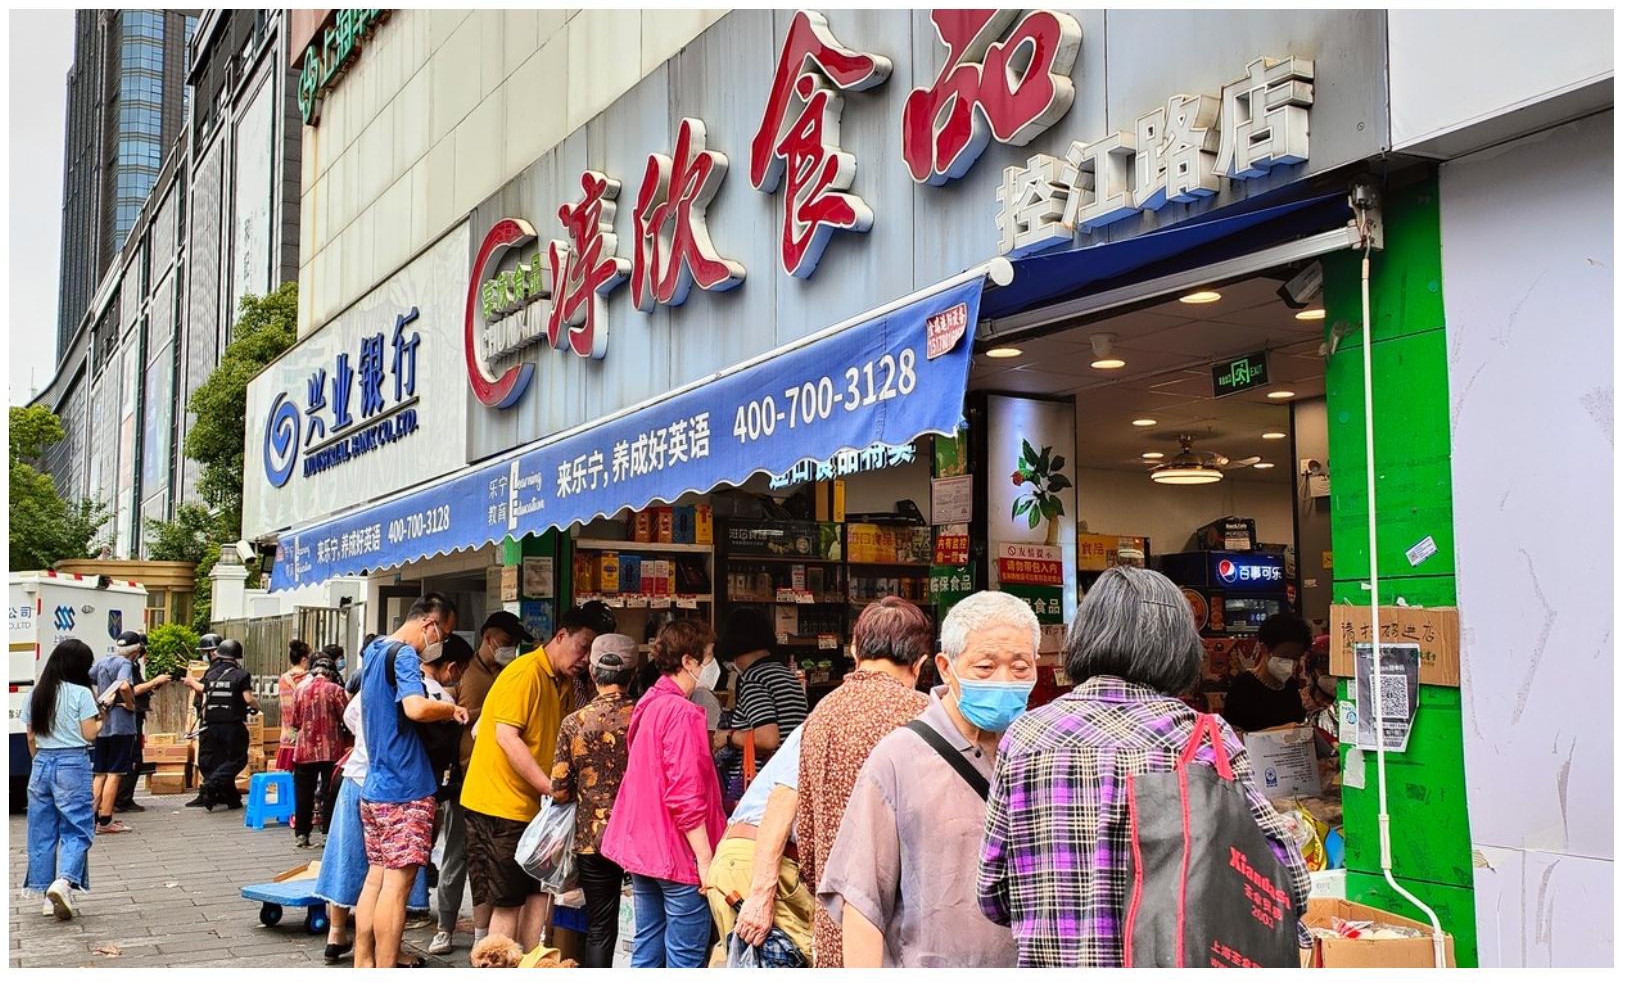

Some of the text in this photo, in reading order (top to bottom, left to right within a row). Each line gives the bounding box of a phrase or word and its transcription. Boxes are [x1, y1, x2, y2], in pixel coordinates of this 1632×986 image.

[546, 9, 1070, 359] 淳欣食品
[995, 55, 1316, 256] 控江路店
[304, 306, 421, 446] 兴业银行
[732, 347, 917, 444] 400-700-3128
[488, 475, 508, 500] 乐宁
[488, 502, 508, 527] 教育
[388, 504, 450, 544] 400-700-3128
[1238, 565, 1283, 581] 百事可乐
